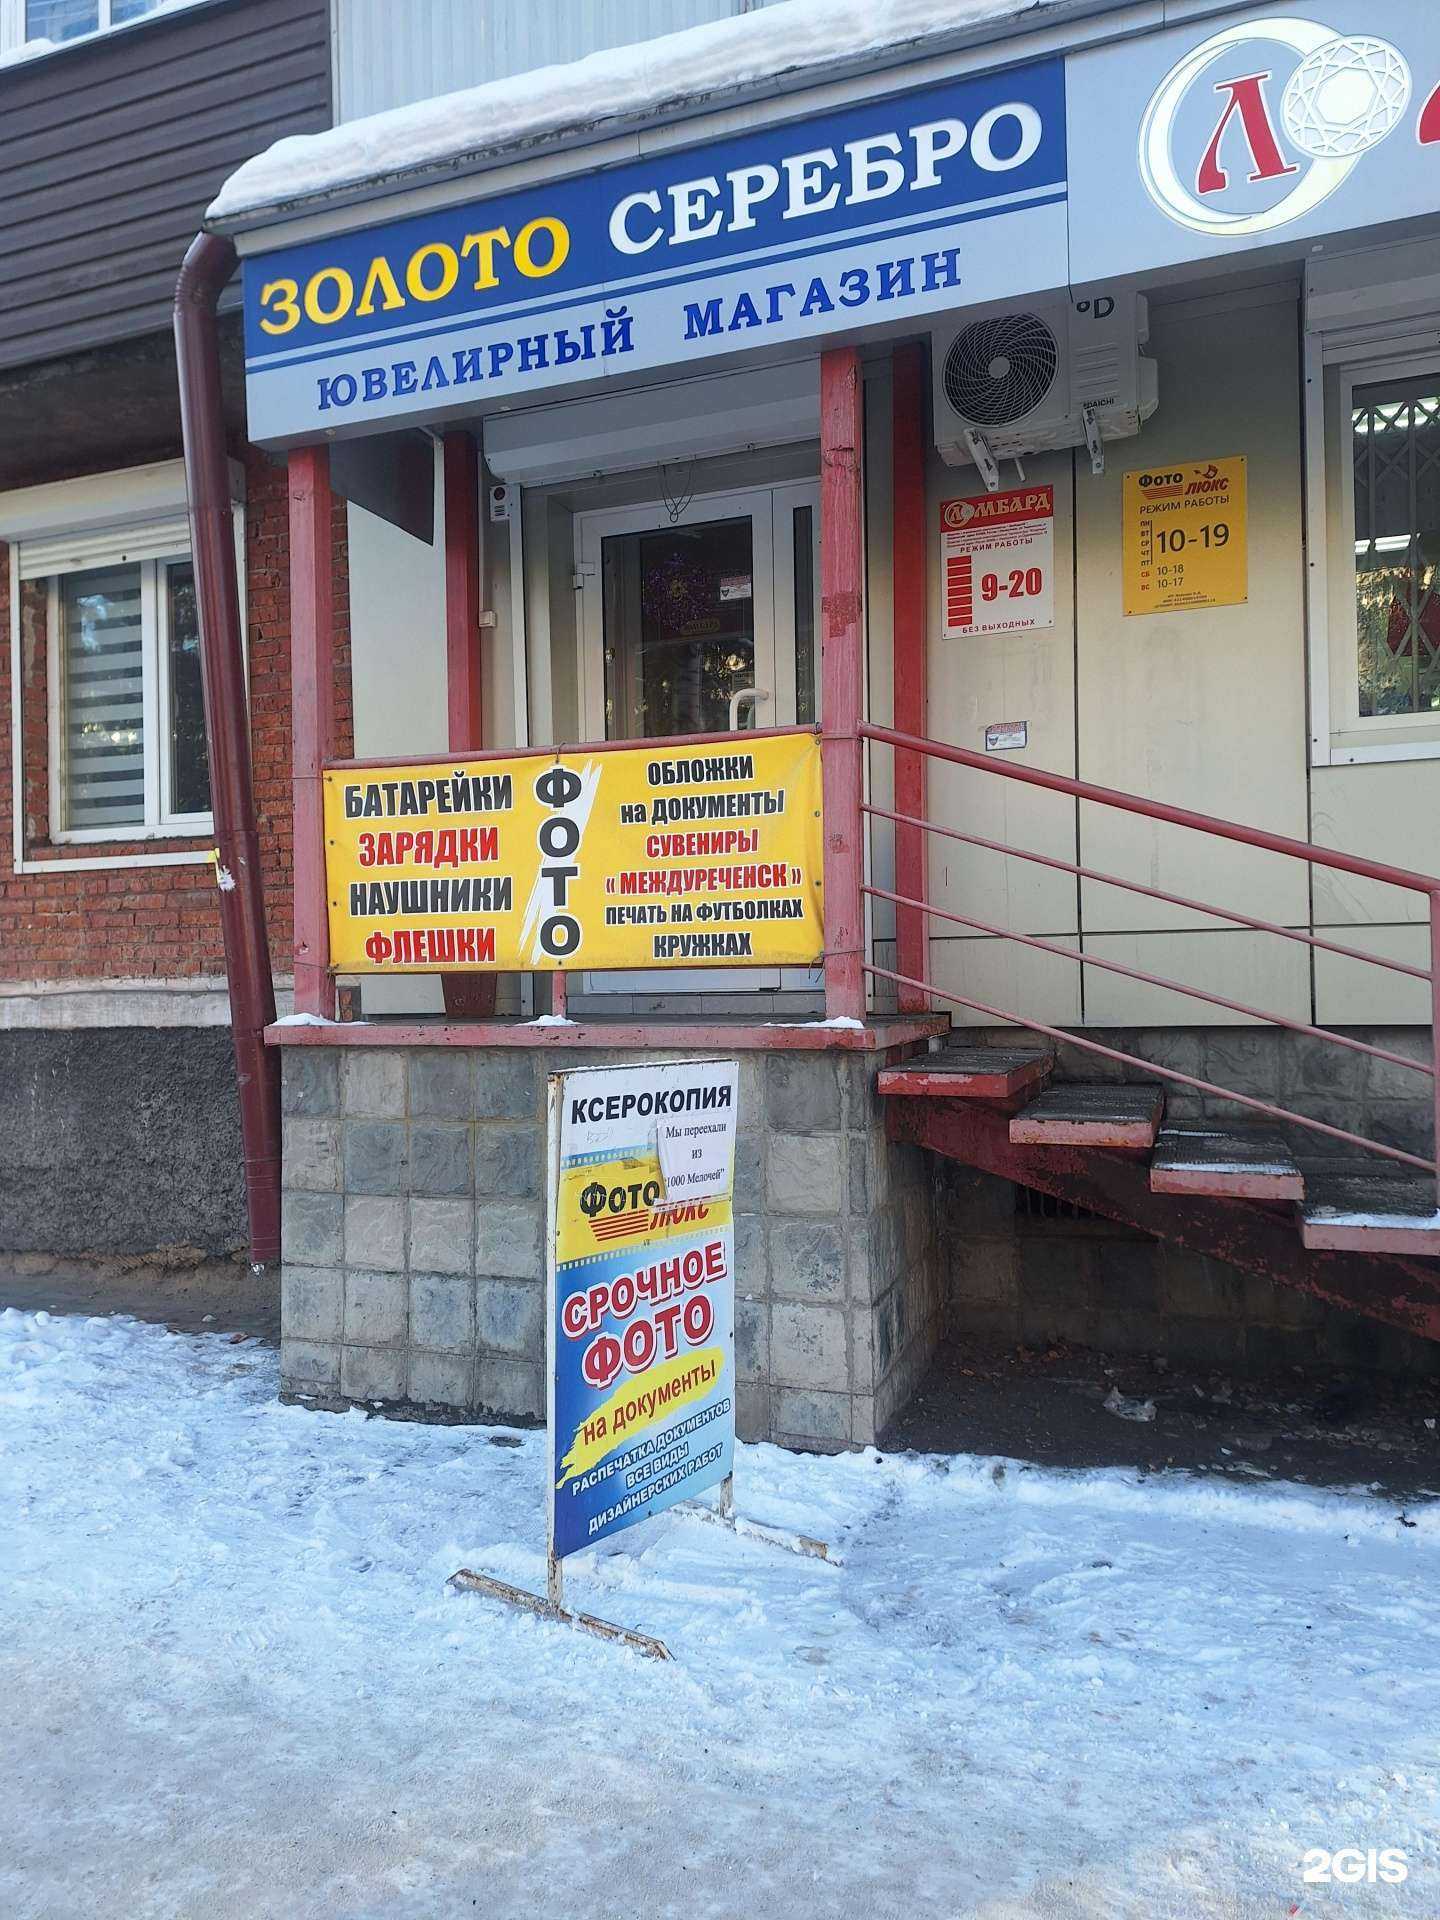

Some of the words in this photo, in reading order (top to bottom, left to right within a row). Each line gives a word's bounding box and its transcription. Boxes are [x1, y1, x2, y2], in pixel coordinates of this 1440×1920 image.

[259, 216, 571, 335] ЗОЛОТО
[608, 101, 1043, 255] СЕРЕБРО
[317, 305, 634, 410] ЮВЕЛИРНЫЙ
[683, 248, 961, 340] МАГАЗИН
[1139, 501, 1181, 515] РЕЖИМ
[1184, 494, 1230, 509] РАБОТЫ
[960, 542, 992, 554] РЕЖИМ
[994, 537, 1033, 549] РАБОТЫ
[1156, 522, 1230, 554] 10-19
[981, 567, 1043, 602] 9-20
[1157, 563, 1184, 576] 10-18
[1157, 577, 1184, 589] 10-17
[962, 625, 979, 634] БЕЗ
[982, 618, 1036, 632] ВЫХОДНЫХ
[647, 755, 754, 786] ОБЛОЖКИ
[344, 770, 513, 818] БАТАРЕЙКИ
[620, 803, 647, 824] на
[651, 789, 785, 825] ДОКУМЕНТЫ
[358, 826, 499, 869] ЗАРЯДКИ
[646, 829, 759, 858] СУВЕНИРЫ
[535, 767, 583, 957] ФОТО
[350, 876, 513, 916] НАУШНИКИ
[605, 903, 667, 925] ПЕЧАТЬ
[670, 903, 693, 923] НА
[696, 898, 804, 922] ФУТБОЛКАХ
[364, 927, 496, 964] ФЛЕШКИ
[653, 931, 753, 959] КРУЖКАХ
[571, 1084, 732, 1125] КСЕРОКОПИЯ
[665, 1126, 682, 1139] Мы
[684, 1123, 727, 1139] переехали
[691, 1148, 703, 1160] из
[564, 1241, 726, 1336] СРОЧНОЕ
[582, 1294, 713, 1386] ФОТО
[583, 1416, 608, 1446] на
[612, 1359, 717, 1435] документы
[571, 1439, 655, 1497] РАСПЕЧАТКА
[655, 1398, 731, 1451] ДОКУМЕНТОВ
[626, 1462, 652, 1489] ВСЕ
[652, 1441, 689, 1474] ВИДЫ
[588, 1464, 686, 1537] ДИЗАЙНЕРСКИХ
[686, 1442, 723, 1476] РАБОТ
